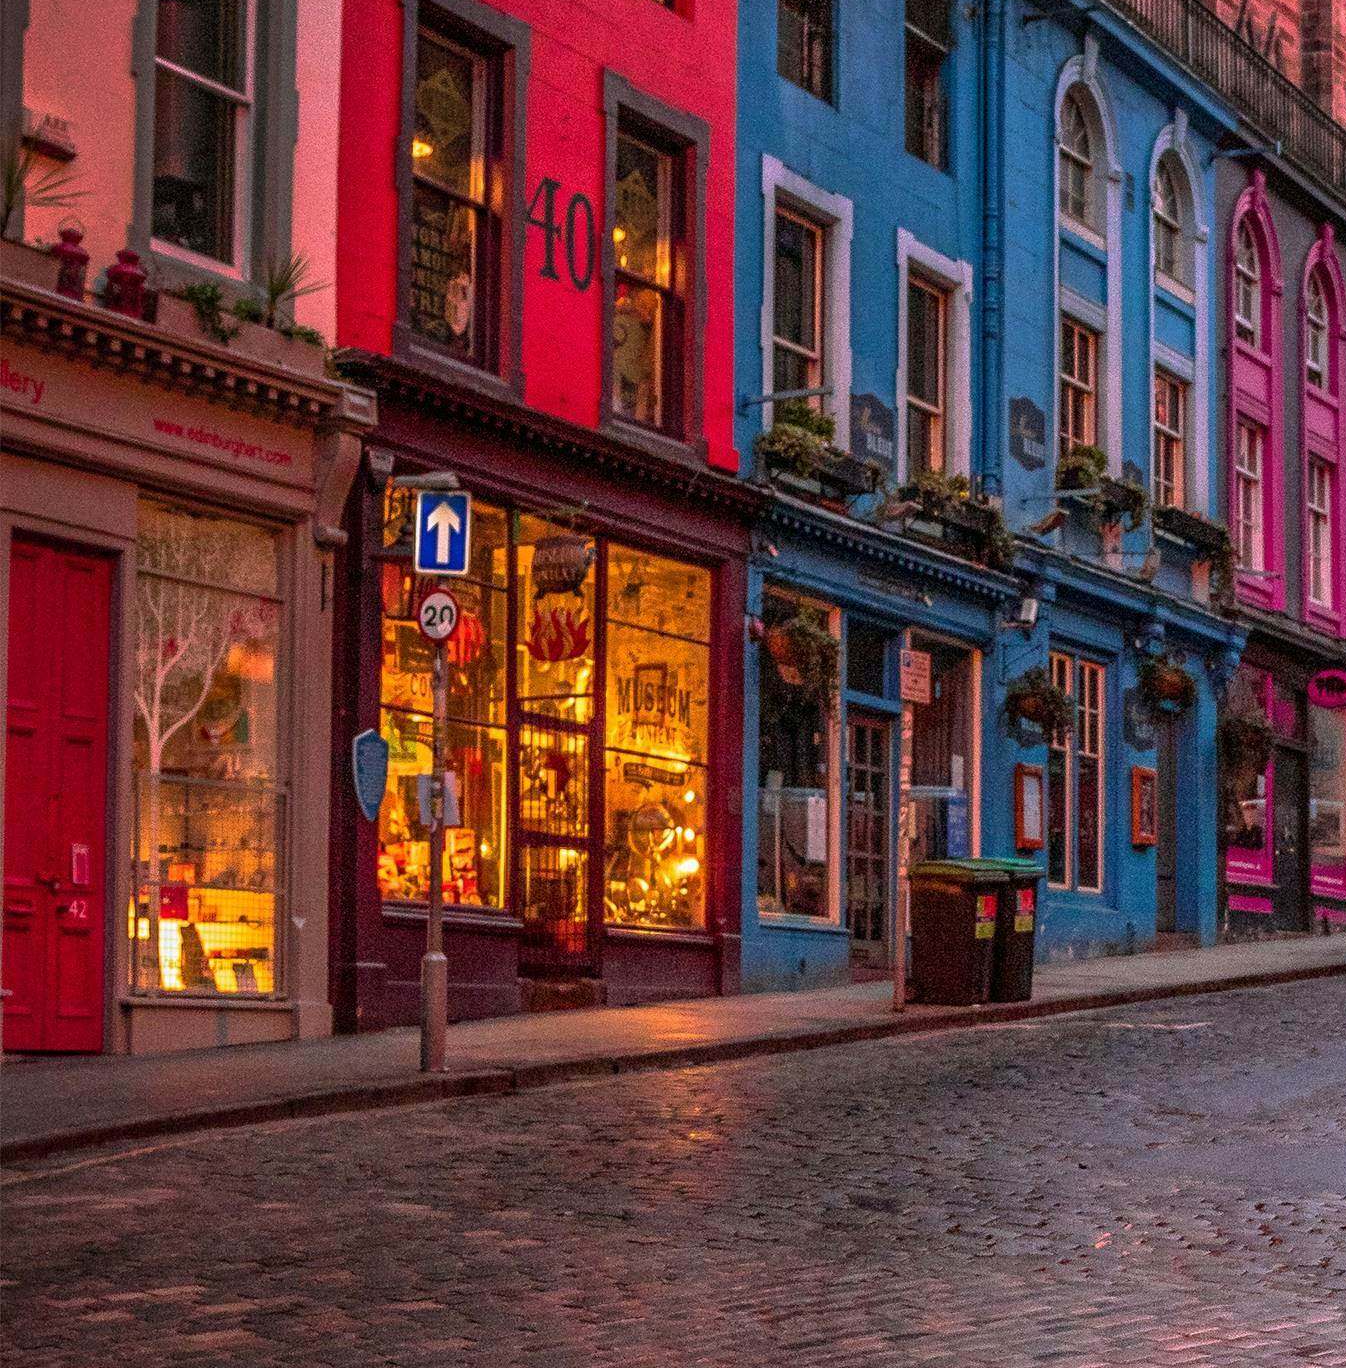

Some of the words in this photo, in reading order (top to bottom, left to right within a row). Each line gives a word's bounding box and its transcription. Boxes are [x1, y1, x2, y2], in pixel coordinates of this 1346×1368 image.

[526, 177, 596, 292] 40
[424, 604, 454, 630] 20
[617, 676, 691, 729] MUSEUM
[69, 900, 87, 918] 42
